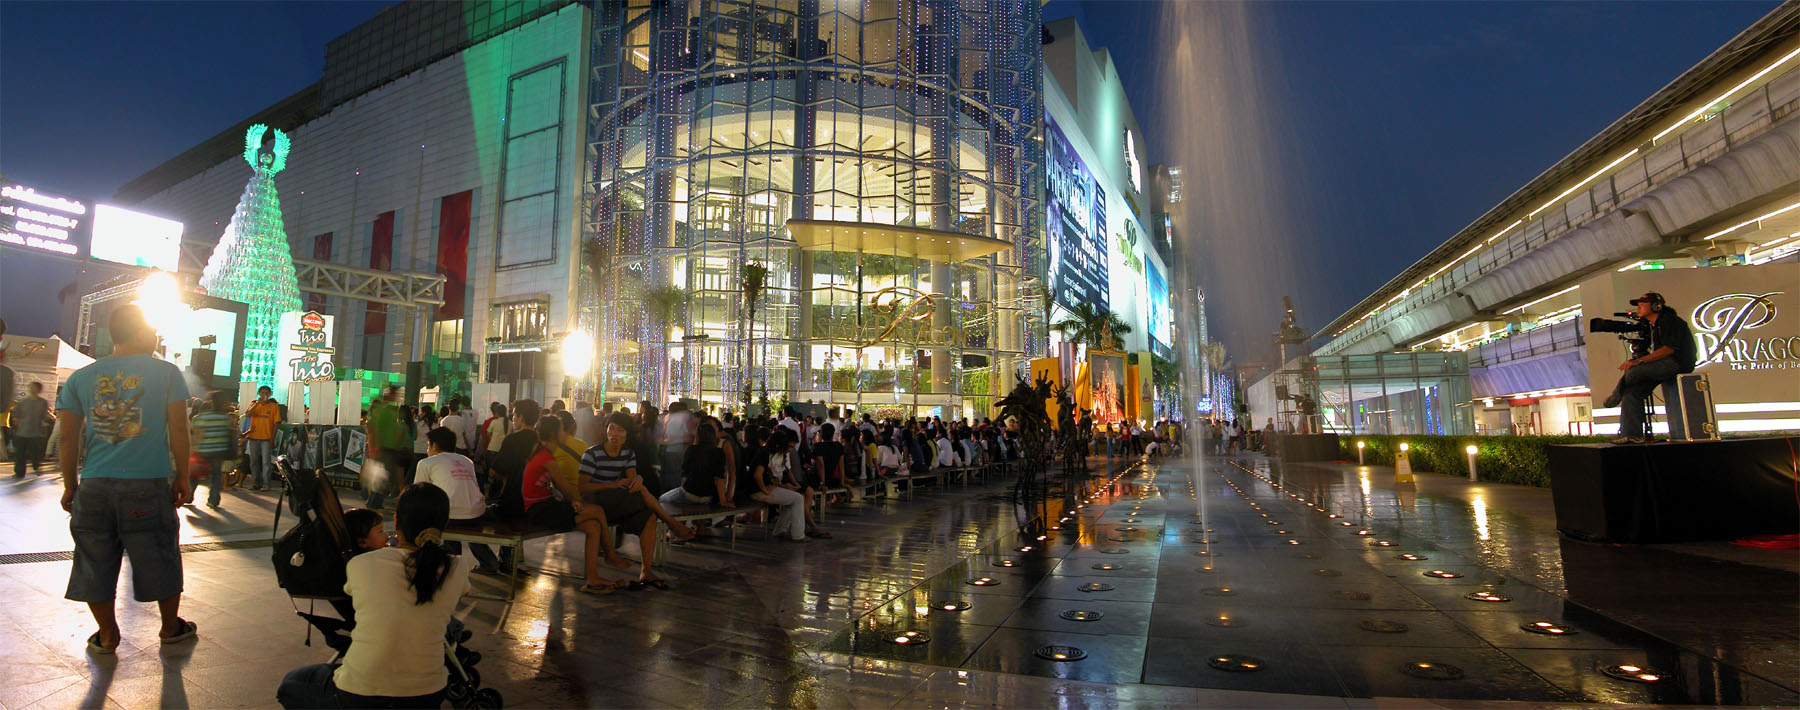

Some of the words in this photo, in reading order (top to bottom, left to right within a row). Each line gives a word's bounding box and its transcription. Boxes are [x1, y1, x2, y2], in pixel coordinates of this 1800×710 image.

[300, 330, 325, 343] Trio
[290, 359, 332, 380] Trio
[1730, 362, 1748, 371] The
[1750, 361, 1774, 370] Pride
[1778, 361, 1787, 370] of
